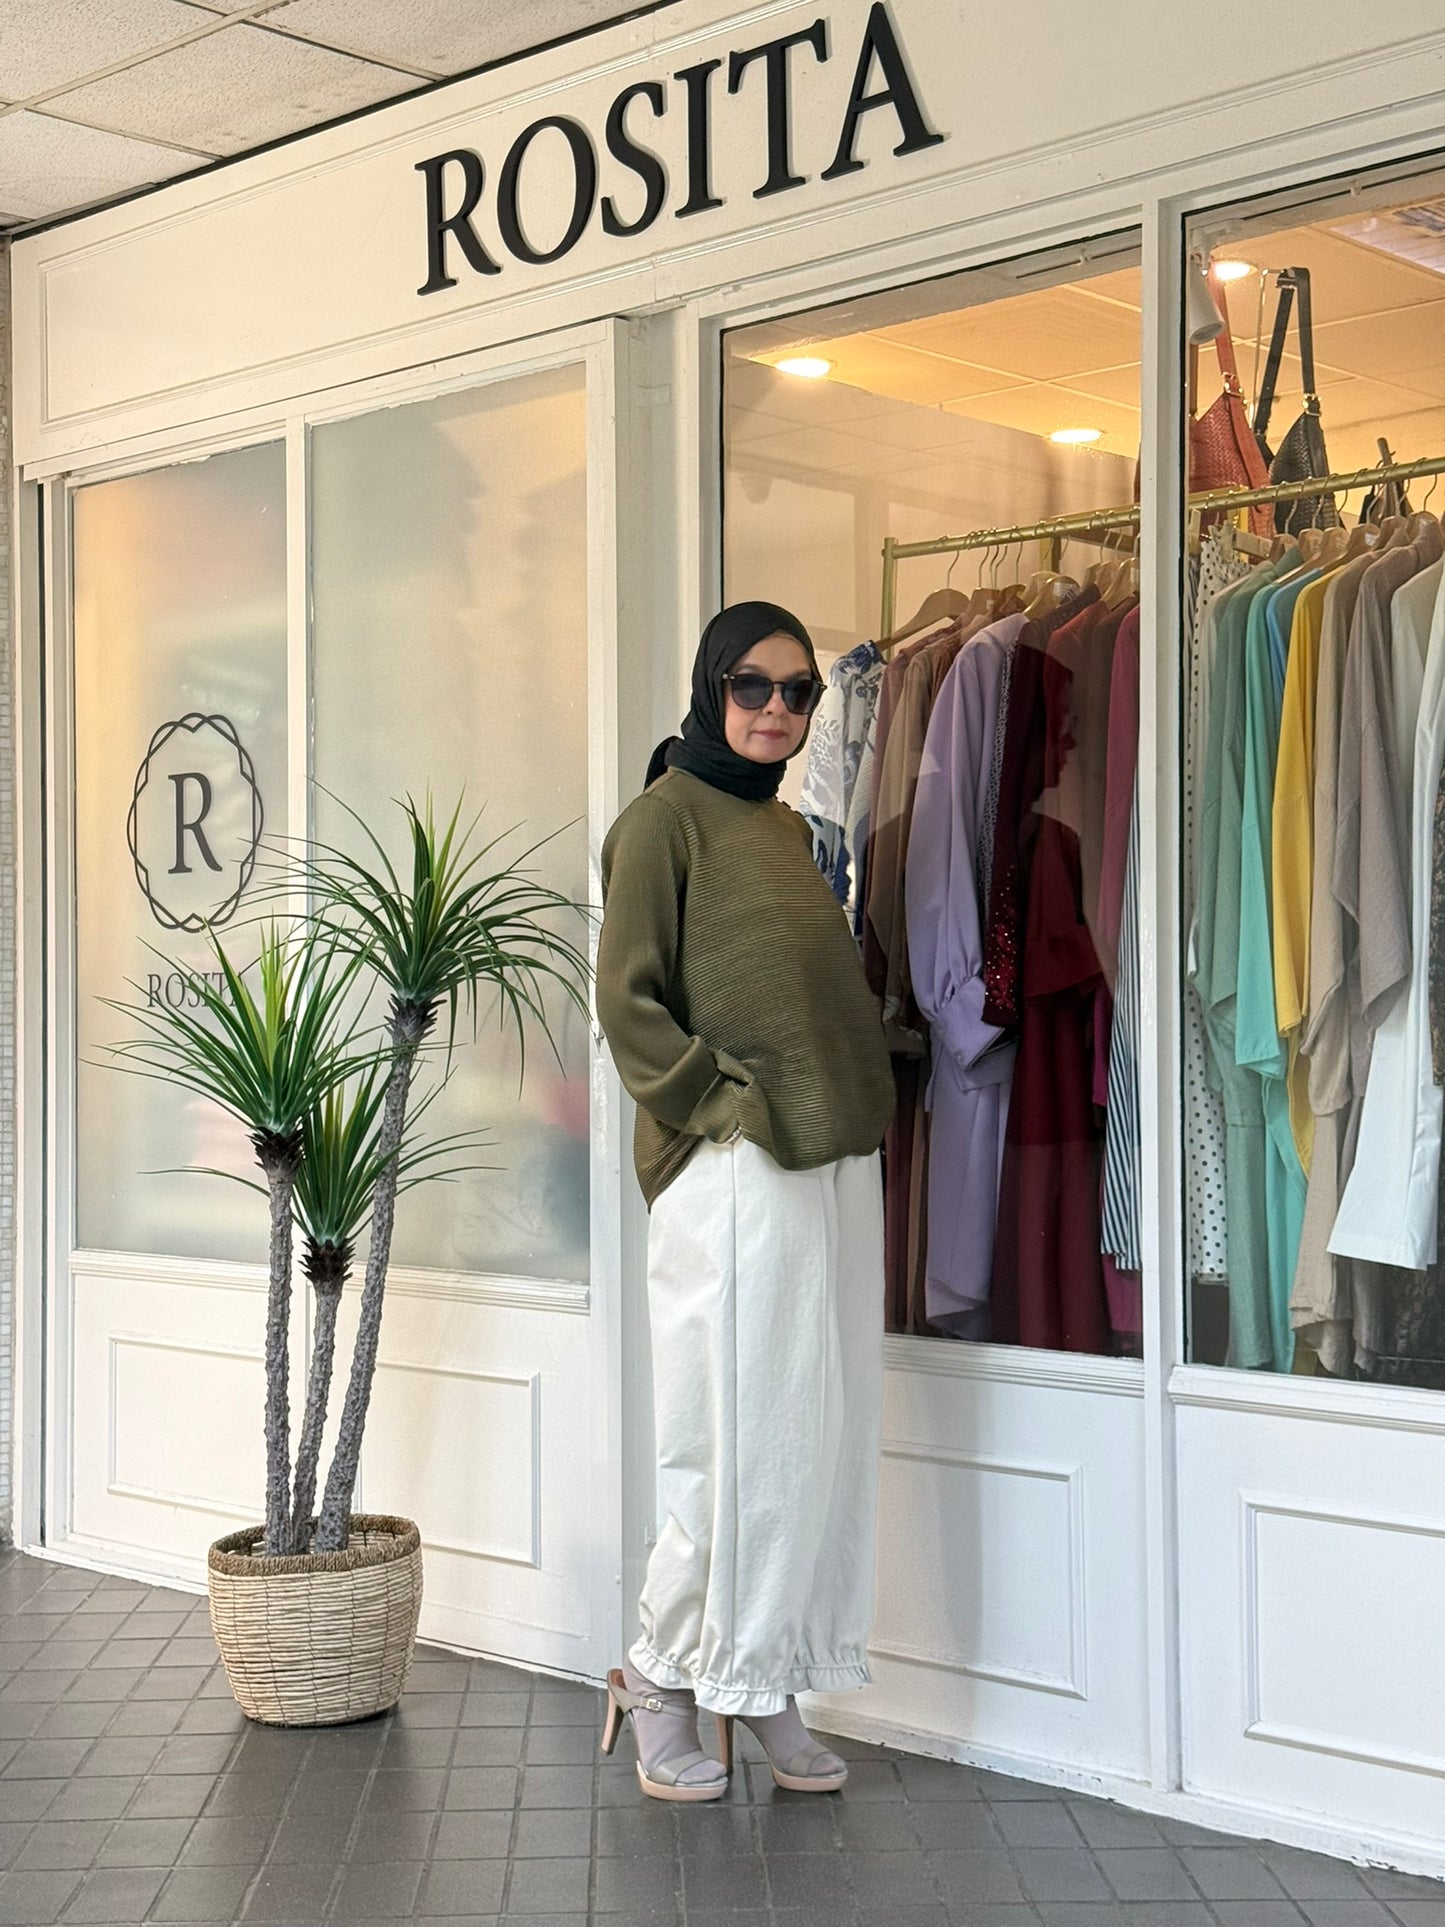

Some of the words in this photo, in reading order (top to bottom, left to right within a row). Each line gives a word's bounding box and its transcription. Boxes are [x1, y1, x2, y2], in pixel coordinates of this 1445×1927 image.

[414, 1, 944, 296] ROSITA
[168, 772, 223, 874] R
[147, 972, 243, 1008] ROSIT
